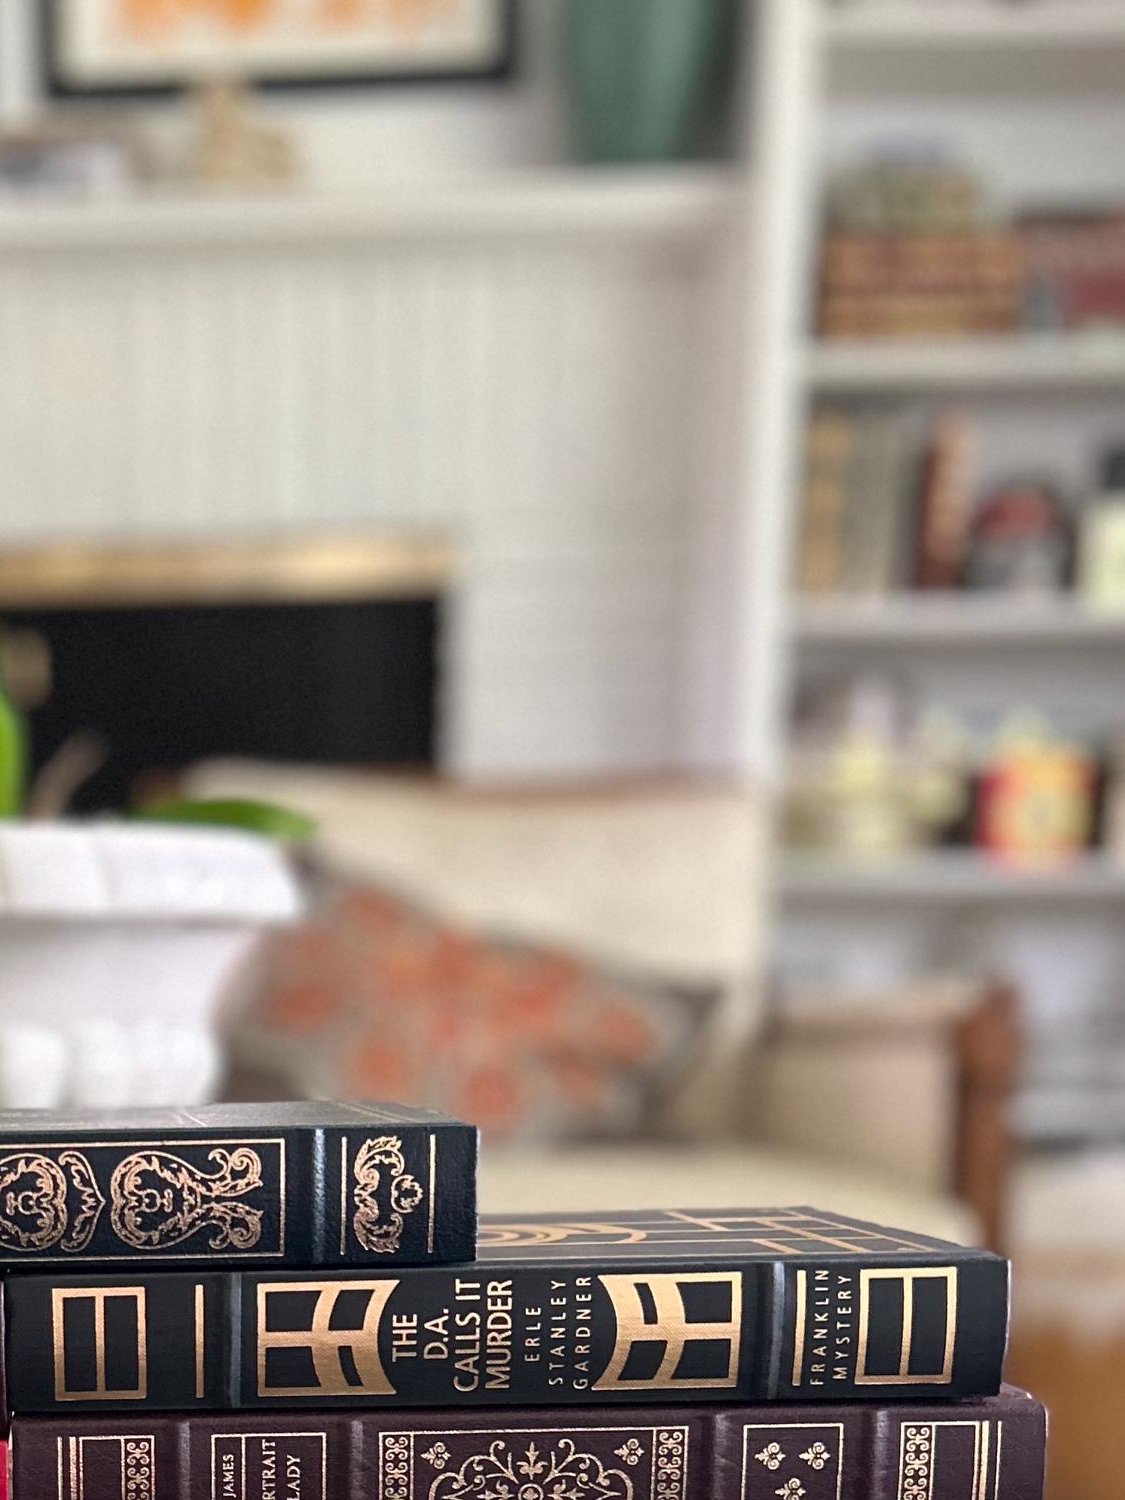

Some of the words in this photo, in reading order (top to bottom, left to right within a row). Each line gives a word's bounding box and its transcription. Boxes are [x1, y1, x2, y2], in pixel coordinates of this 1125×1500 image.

[454, 1278, 481, 1301] IT
[810, 1269, 829, 1385] FRANKLIN
[832, 1275, 852, 1380] MYSTERY
[391, 1313, 418, 1362] THE
[423, 1308, 449, 1360] D.A.
[453, 1311, 481, 1392] CALLS
[484, 1279, 513, 1390] MURDER
[524, 1306, 541, 1362] ERLE
[548, 1279, 567, 1385] STANLEY
[573, 1276, 592, 1390] GARDNER
[222, 1453, 237, 1498] JAMES
